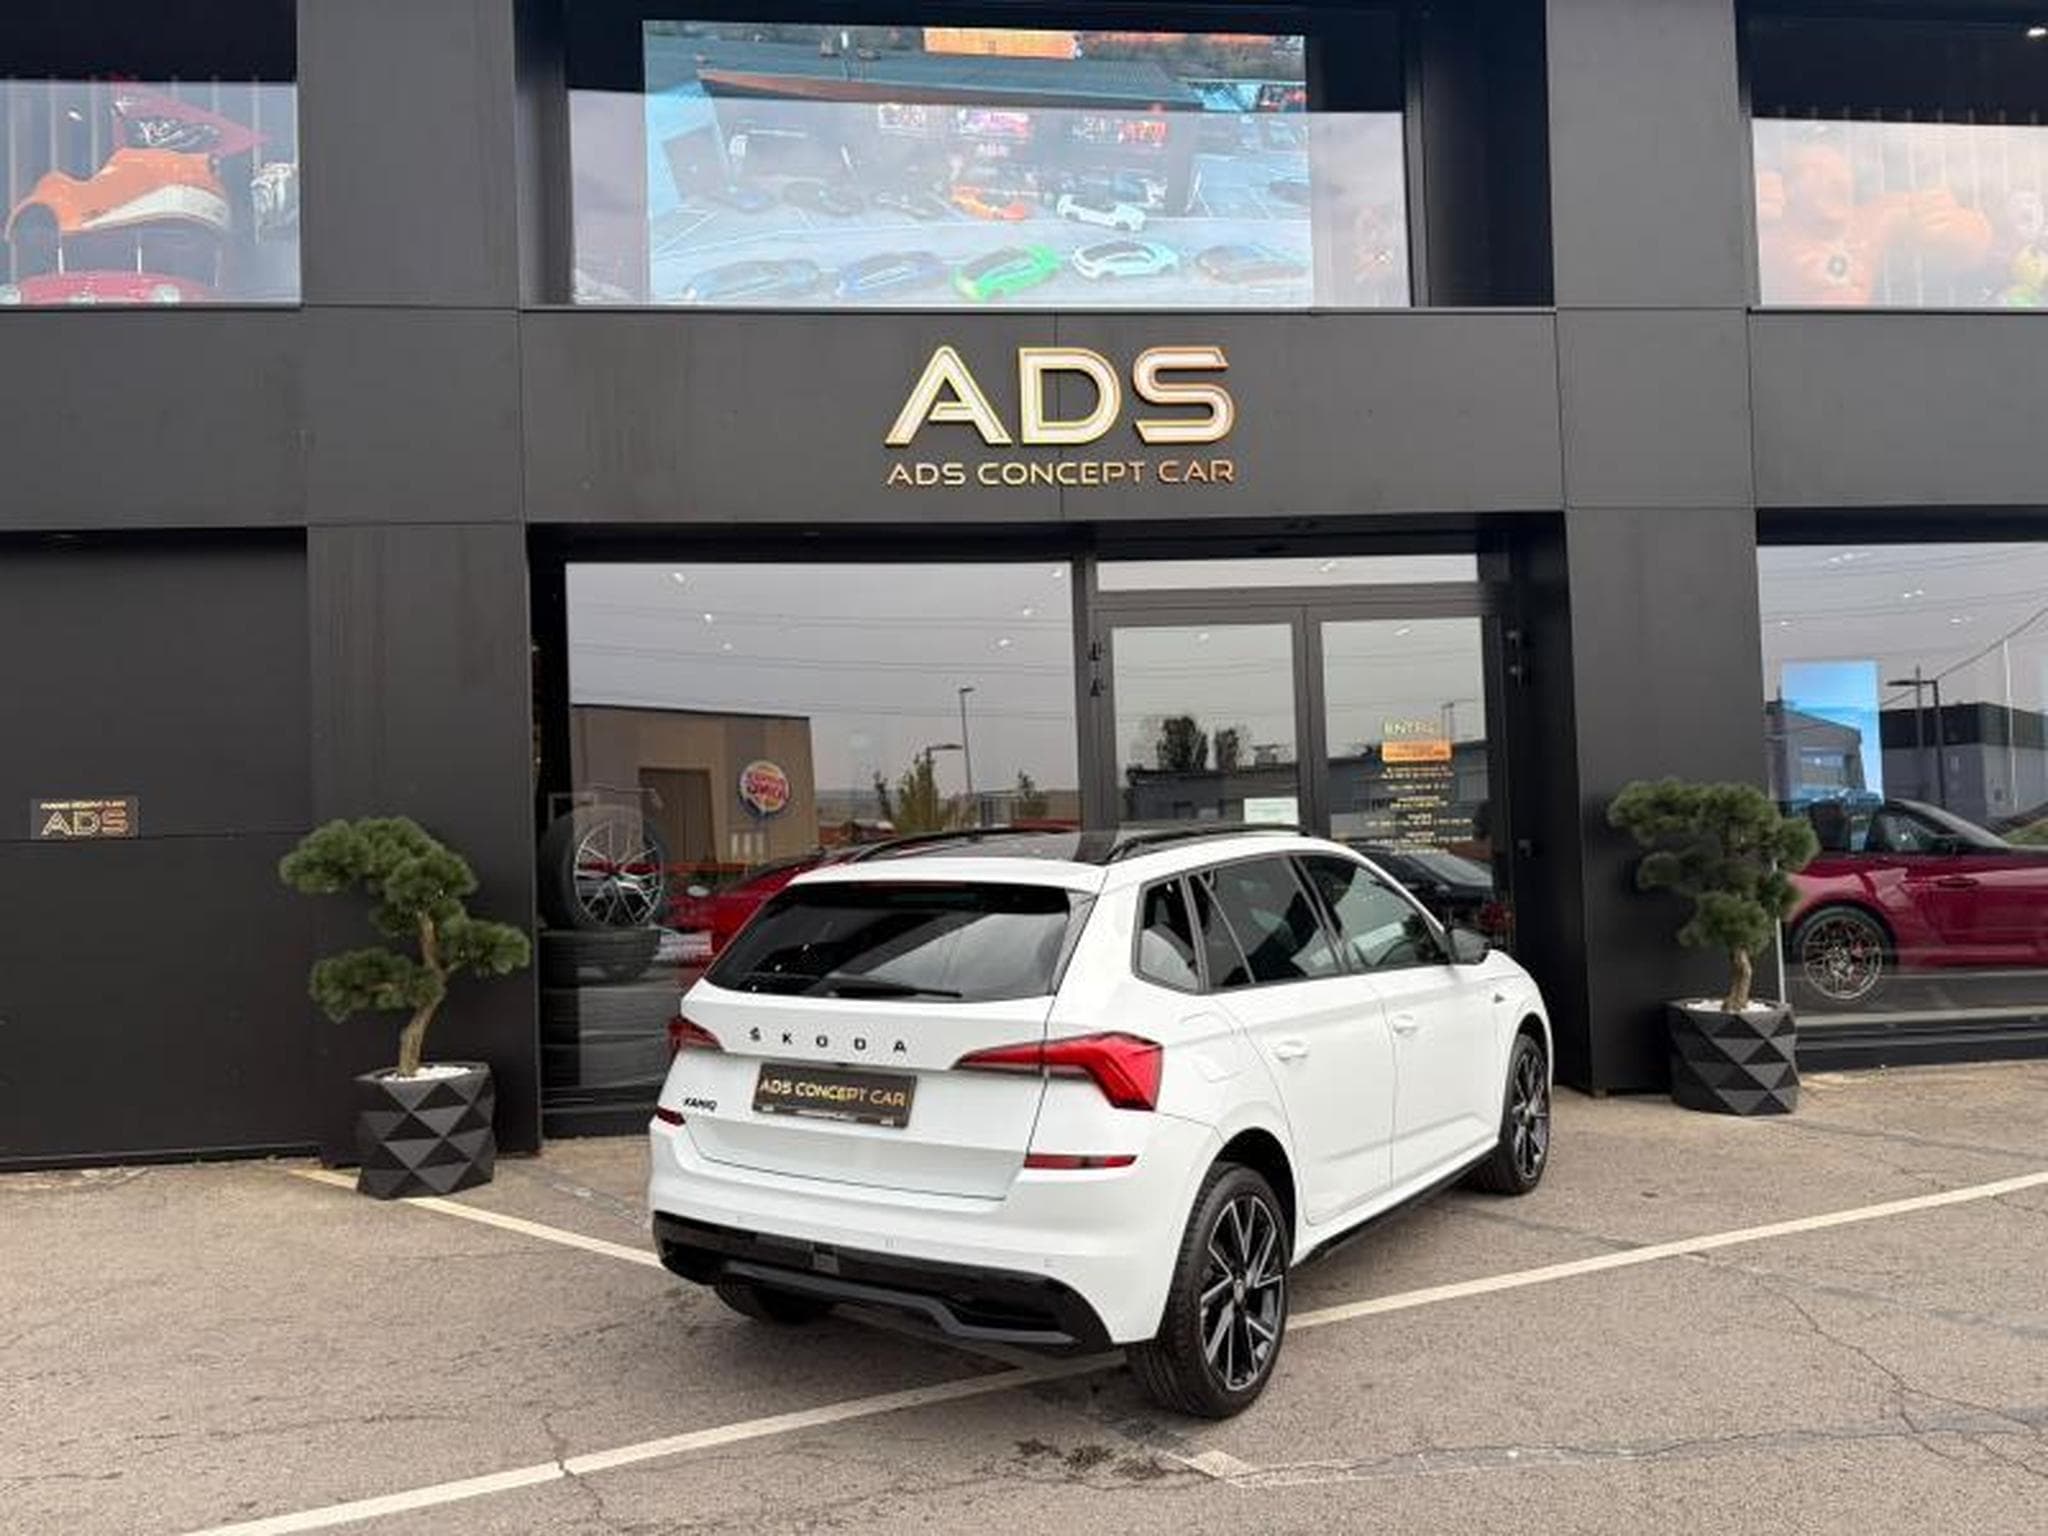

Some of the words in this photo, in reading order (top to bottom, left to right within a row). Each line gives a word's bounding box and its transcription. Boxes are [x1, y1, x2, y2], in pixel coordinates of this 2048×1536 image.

[885, 346, 1235, 445] ADS
[887, 463, 966, 486] ADS
[977, 461, 1145, 486] CONCEPT
[1158, 460, 1235, 484] CAR
[40, 810, 128, 836] ADS
[759, 1078, 793, 1095] ADS
[794, 1082, 868, 1102] CONCEPT
[869, 1089, 906, 1107] CAR
